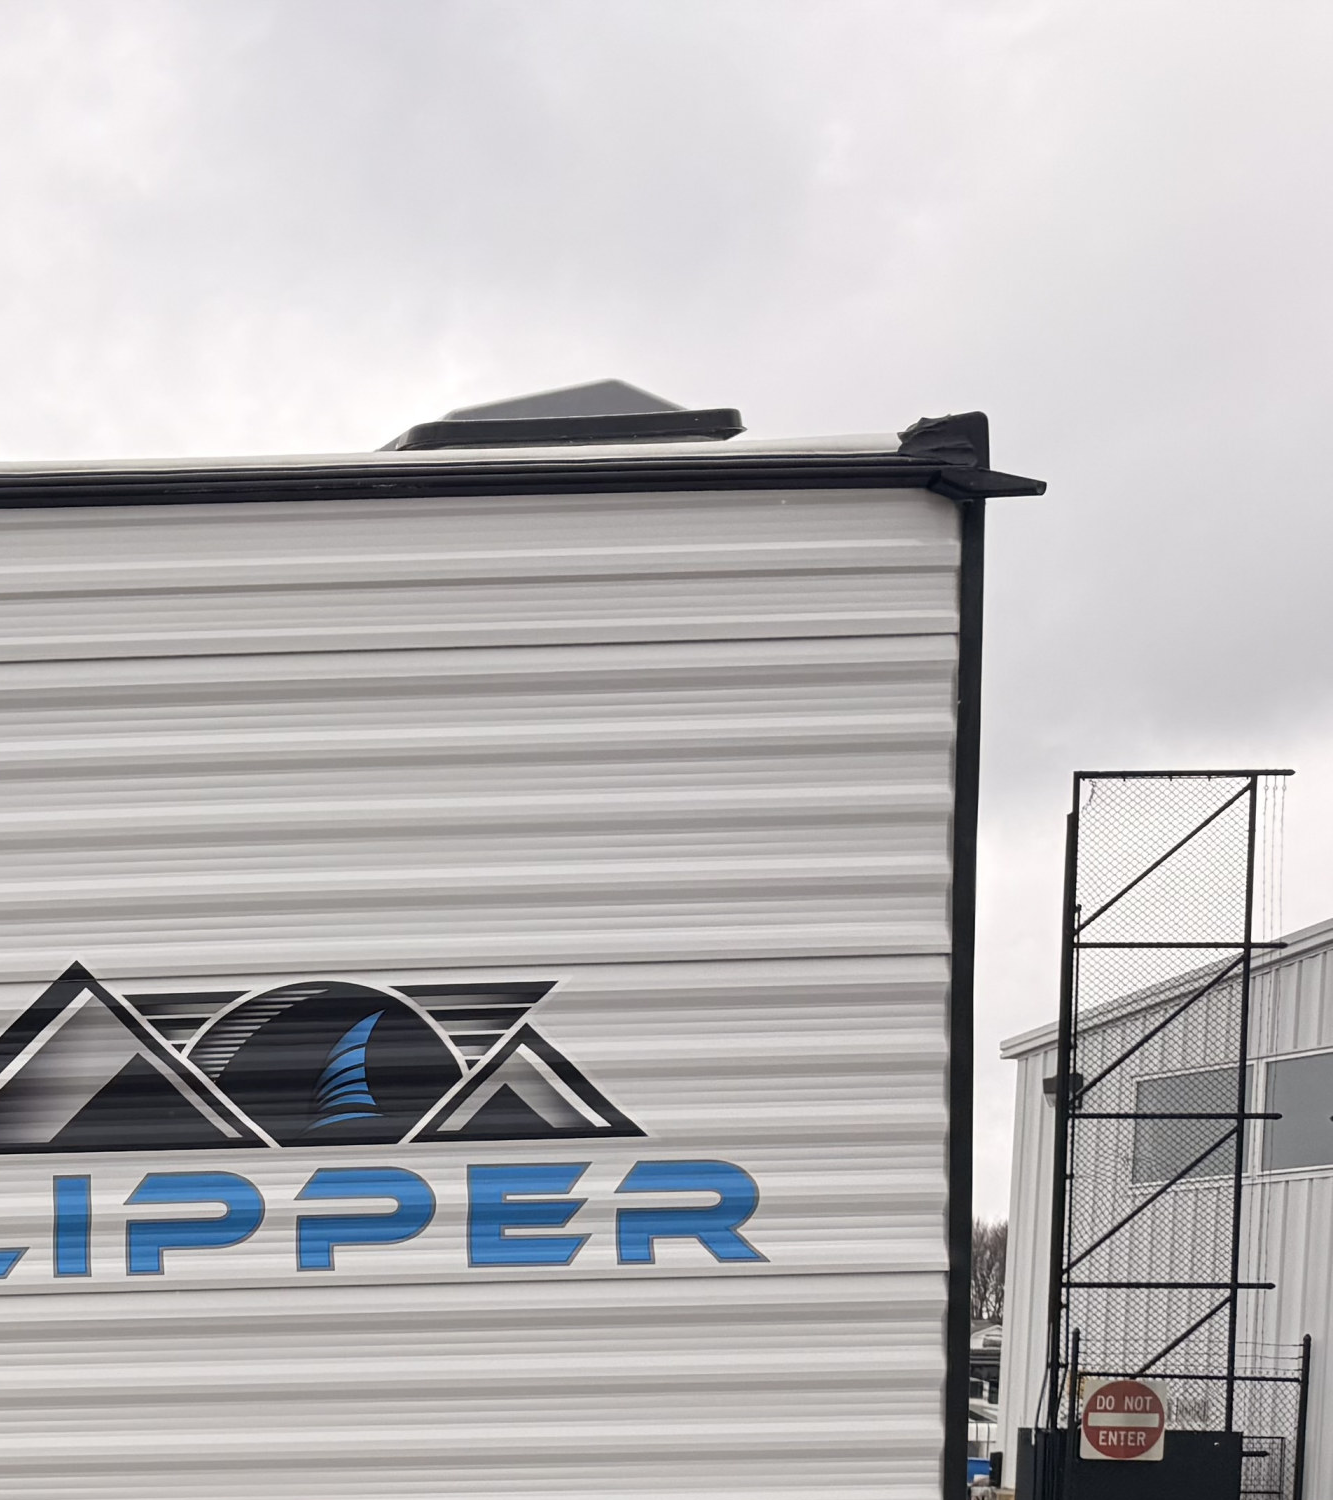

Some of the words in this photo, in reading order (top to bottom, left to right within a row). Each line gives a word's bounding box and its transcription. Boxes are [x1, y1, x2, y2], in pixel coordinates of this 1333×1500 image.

[1096, 1396, 1115, 1411] DO
[1124, 1396, 1153, 1412] NOT
[1098, 1431, 1147, 1447] ENTER
